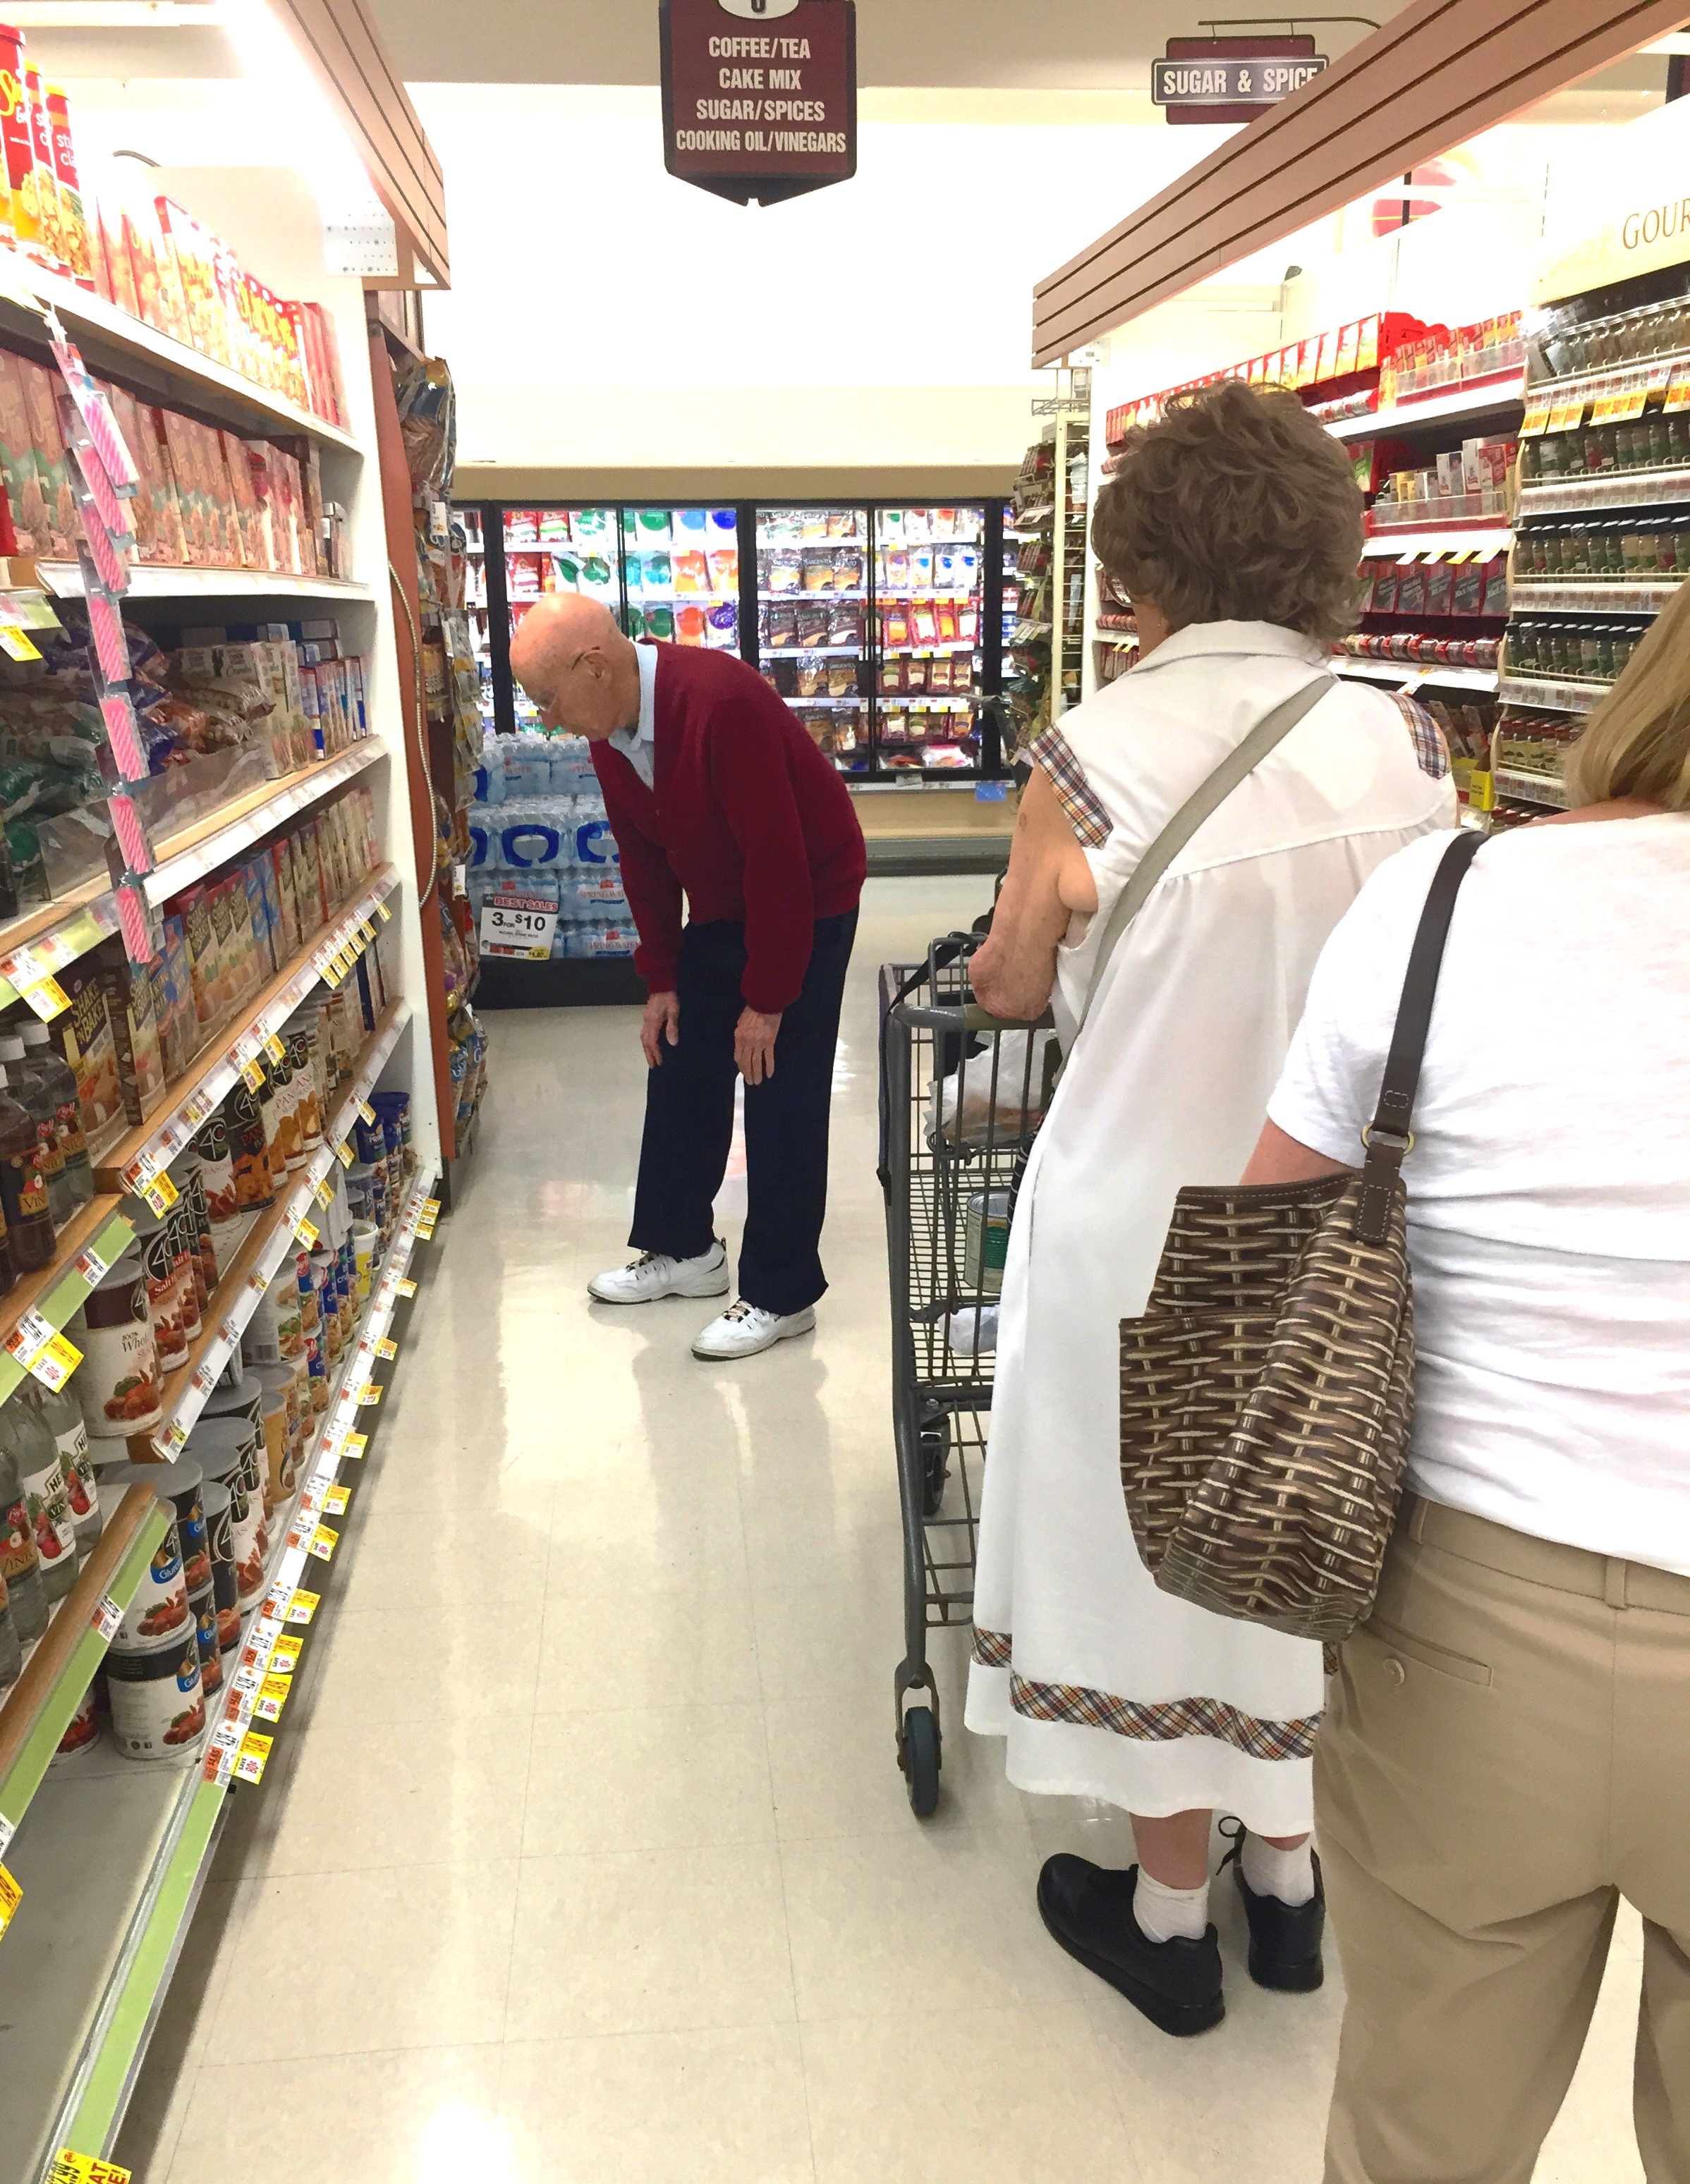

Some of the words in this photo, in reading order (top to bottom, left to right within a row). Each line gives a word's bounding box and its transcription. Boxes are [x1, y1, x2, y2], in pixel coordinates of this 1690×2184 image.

[709, 36, 811, 59] COFFEE/TEA
[719, 68, 764, 89] CAKE
[769, 69, 802, 90] MIX
[1164, 70, 1227, 94] SUGAR
[1237, 69, 1252, 93] &
[696, 99, 825, 121] SUGAR/SPICES
[676, 130, 741, 151] COOKING
[745, 131, 846, 153] OIL/VINEGARS
[494, 896, 526, 909] BEST
[526, 900, 559, 912] SALES
[492, 912, 504, 926] 3
[515, 913, 546, 931] $10
[36, 1358, 47, 1372] SAVE
[257, 1700, 266, 1711] SAVE
[238, 1757, 247, 1770] SAVE
